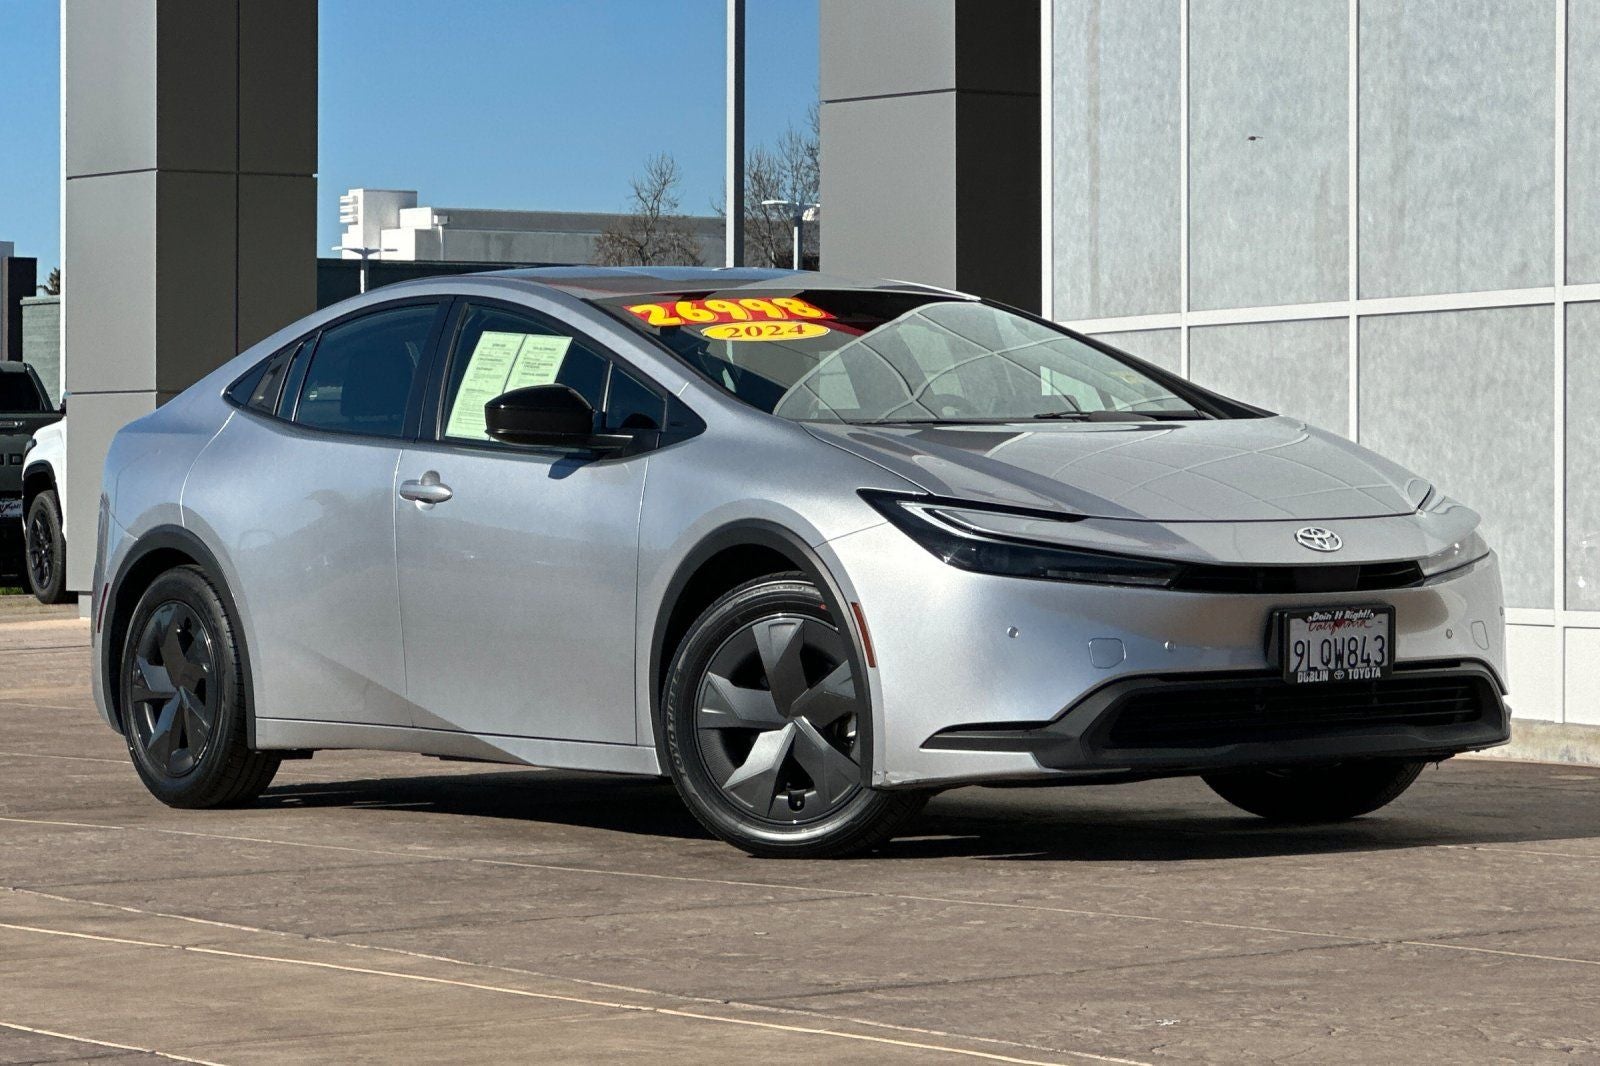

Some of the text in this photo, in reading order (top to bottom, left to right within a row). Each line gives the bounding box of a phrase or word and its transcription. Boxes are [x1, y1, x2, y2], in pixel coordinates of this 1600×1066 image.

[629, 297, 825, 326] 26998
[723, 323, 806, 339] 2024
[1294, 635, 1385, 673] 9LQW843
[1297, 667, 1381, 683] DUBLIN TOYOTA
